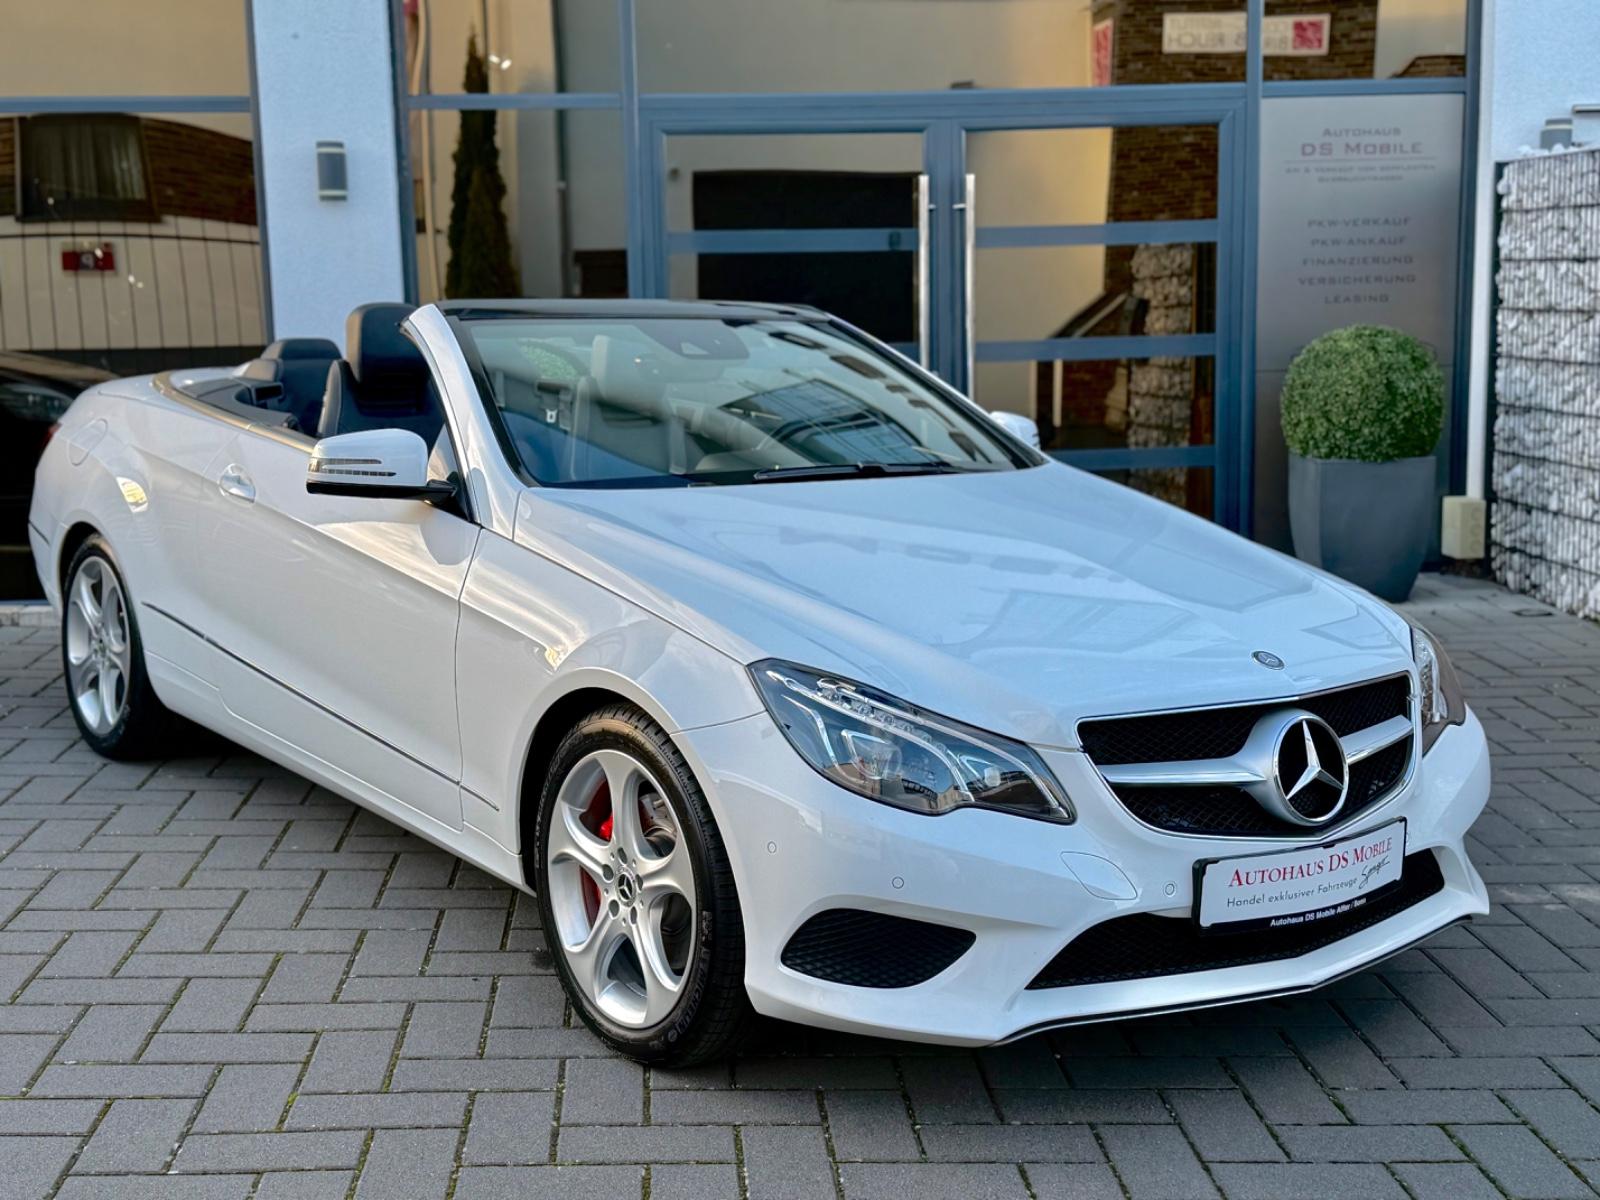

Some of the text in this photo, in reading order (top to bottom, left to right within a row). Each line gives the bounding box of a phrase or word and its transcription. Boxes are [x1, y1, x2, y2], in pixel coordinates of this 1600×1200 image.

[1322, 127, 1402, 138] AUTOHAUS
[1301, 141, 1424, 157] DS MOBILE
[1302, 255, 1413, 267] FINANZIERUNG
[1298, 274, 1416, 286] VERSICHERUNG
[1324, 294, 1390, 305] LEASING
[1228, 837, 1392, 888] AUTOHAUS DS MOBILE
[1227, 877, 1358, 908] Handel exklusiver Fahrzeuge
[1270, 916, 1304, 928] Autohaus
[1305, 912, 1315, 921] DS
[1316, 908, 1336, 919] Mobile
